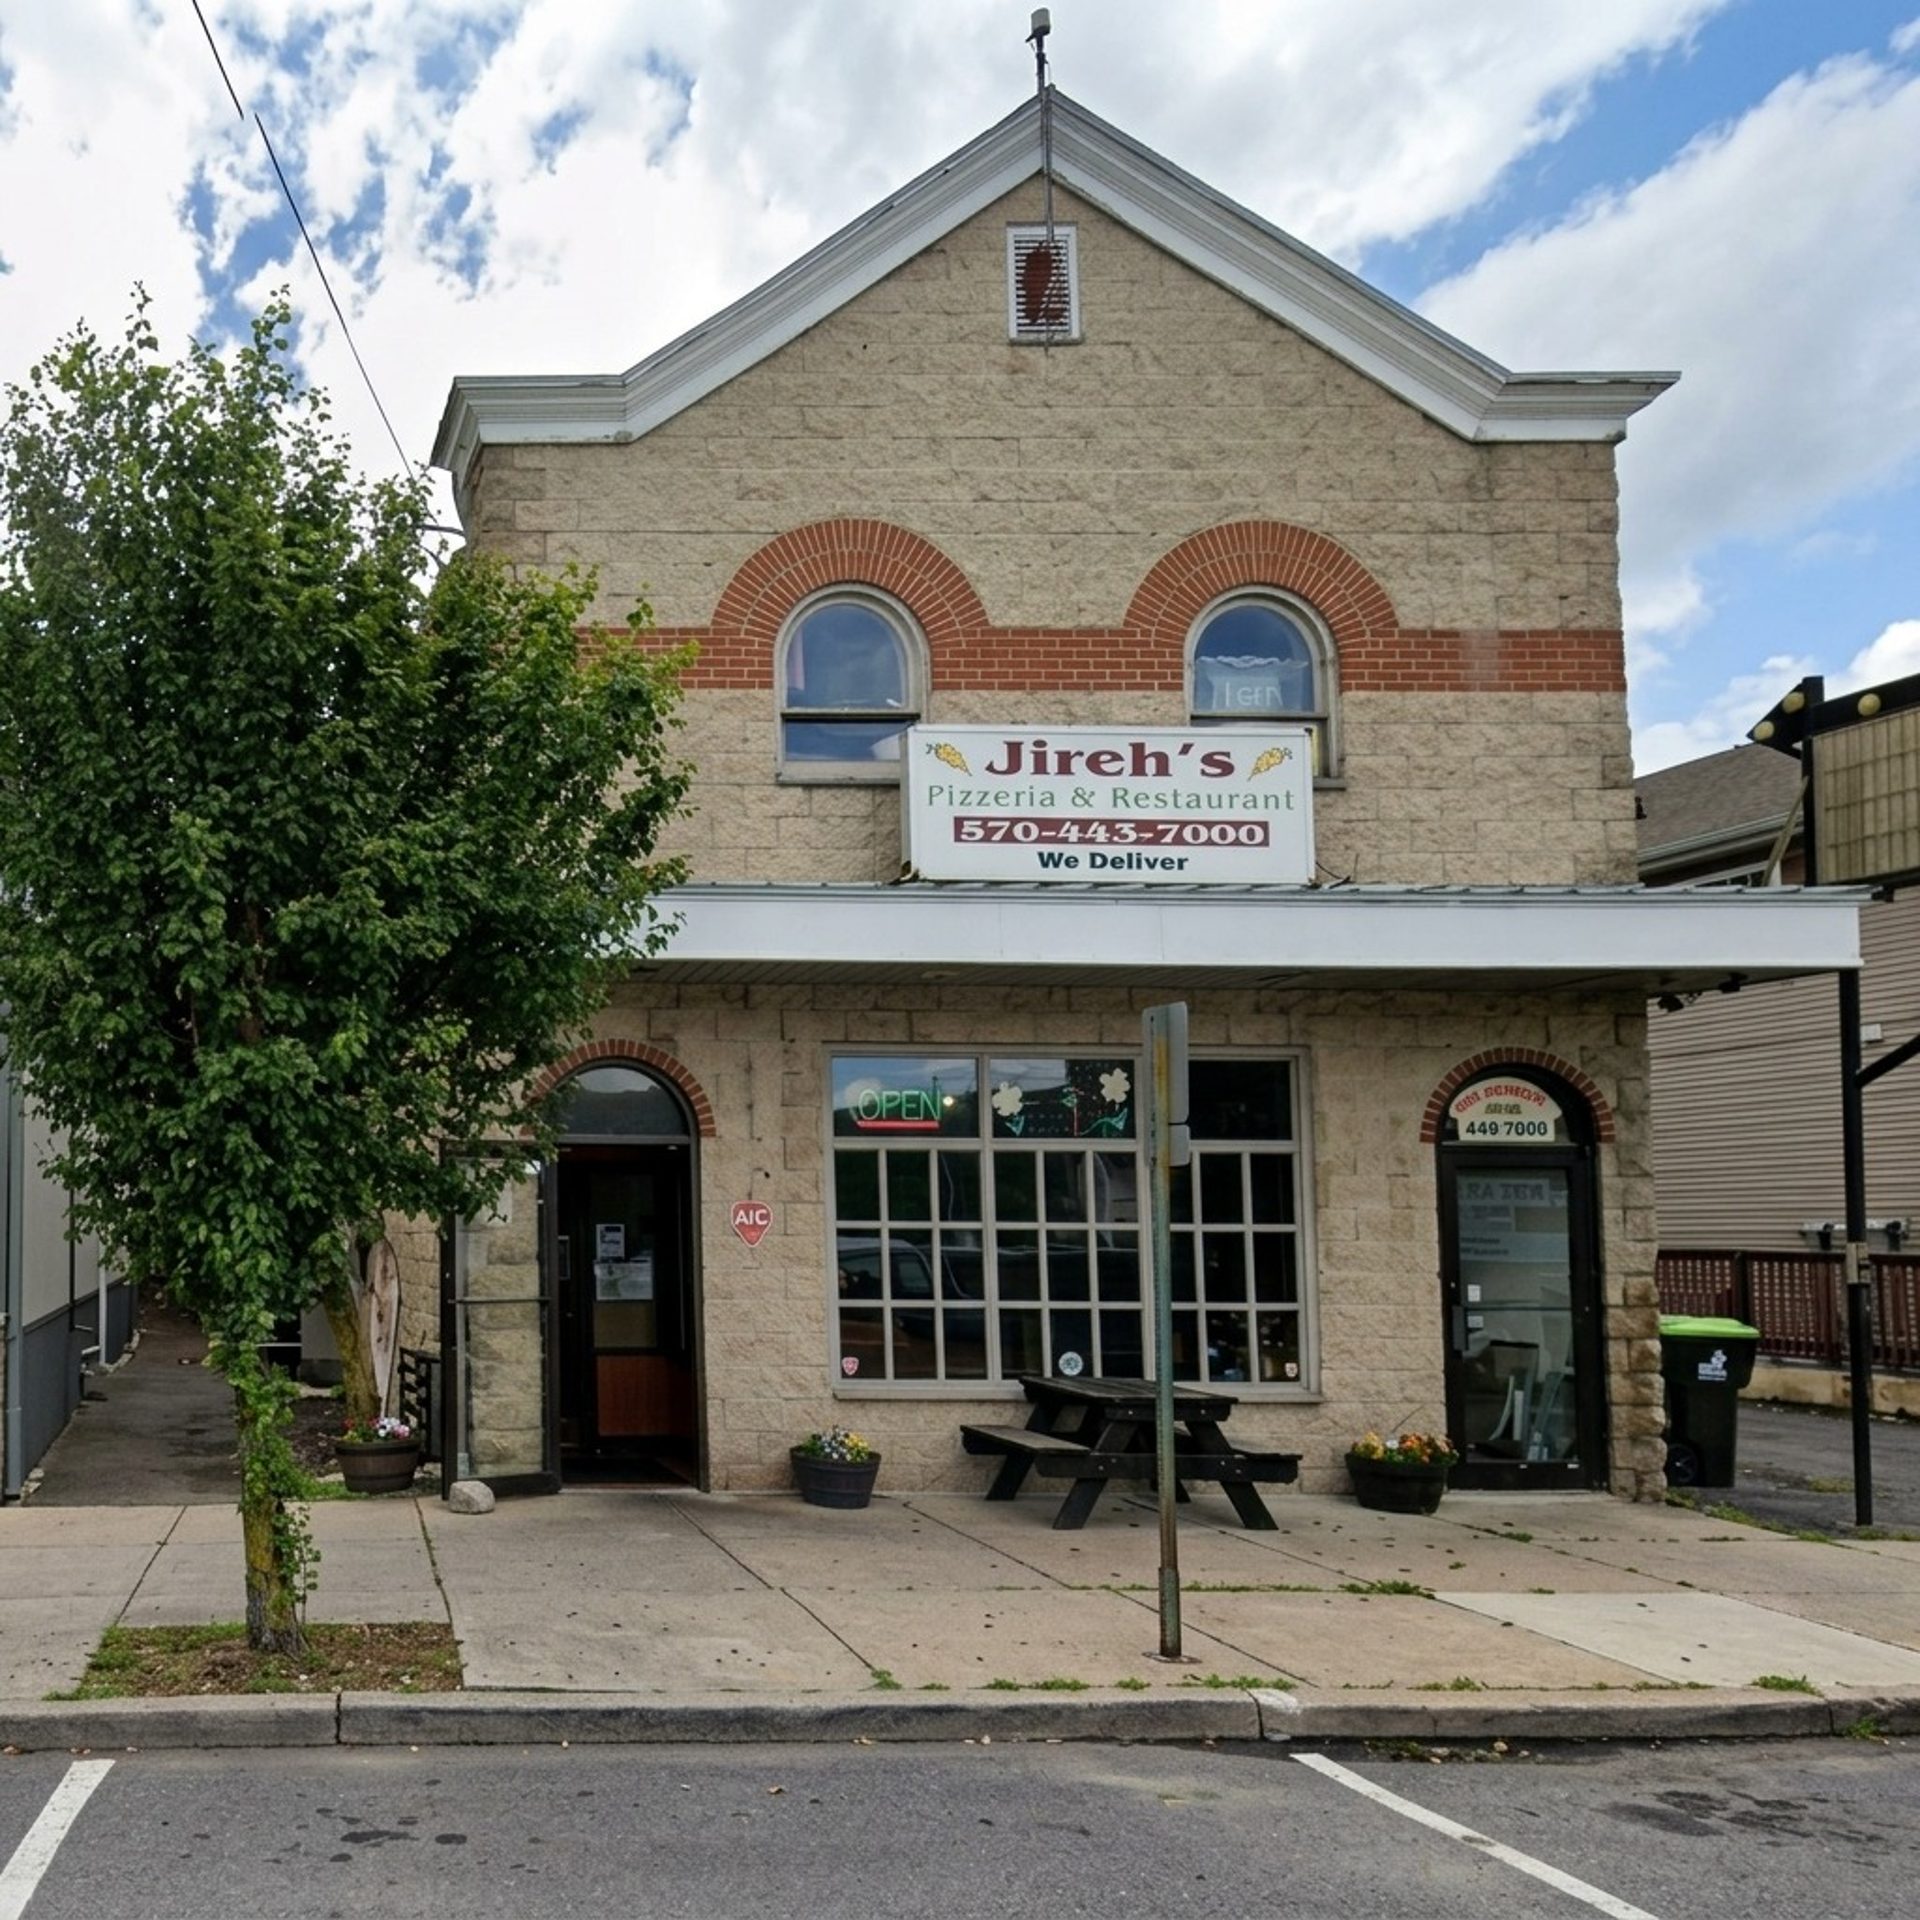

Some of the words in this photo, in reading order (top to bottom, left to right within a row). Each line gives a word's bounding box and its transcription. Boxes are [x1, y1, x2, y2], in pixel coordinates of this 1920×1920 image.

[985, 740, 1235, 777] Jireh's
[928, 785, 1056, 808] Pizzeria
[1071, 787, 1095, 808] &
[1112, 787, 1295, 811] Restaurant
[960, 820, 1265, 845] 570-443-7000
[1038, 852, 1079, 870] We
[1089, 852, 1189, 871] Deliver
[858, 1089, 941, 1121] OPEN
